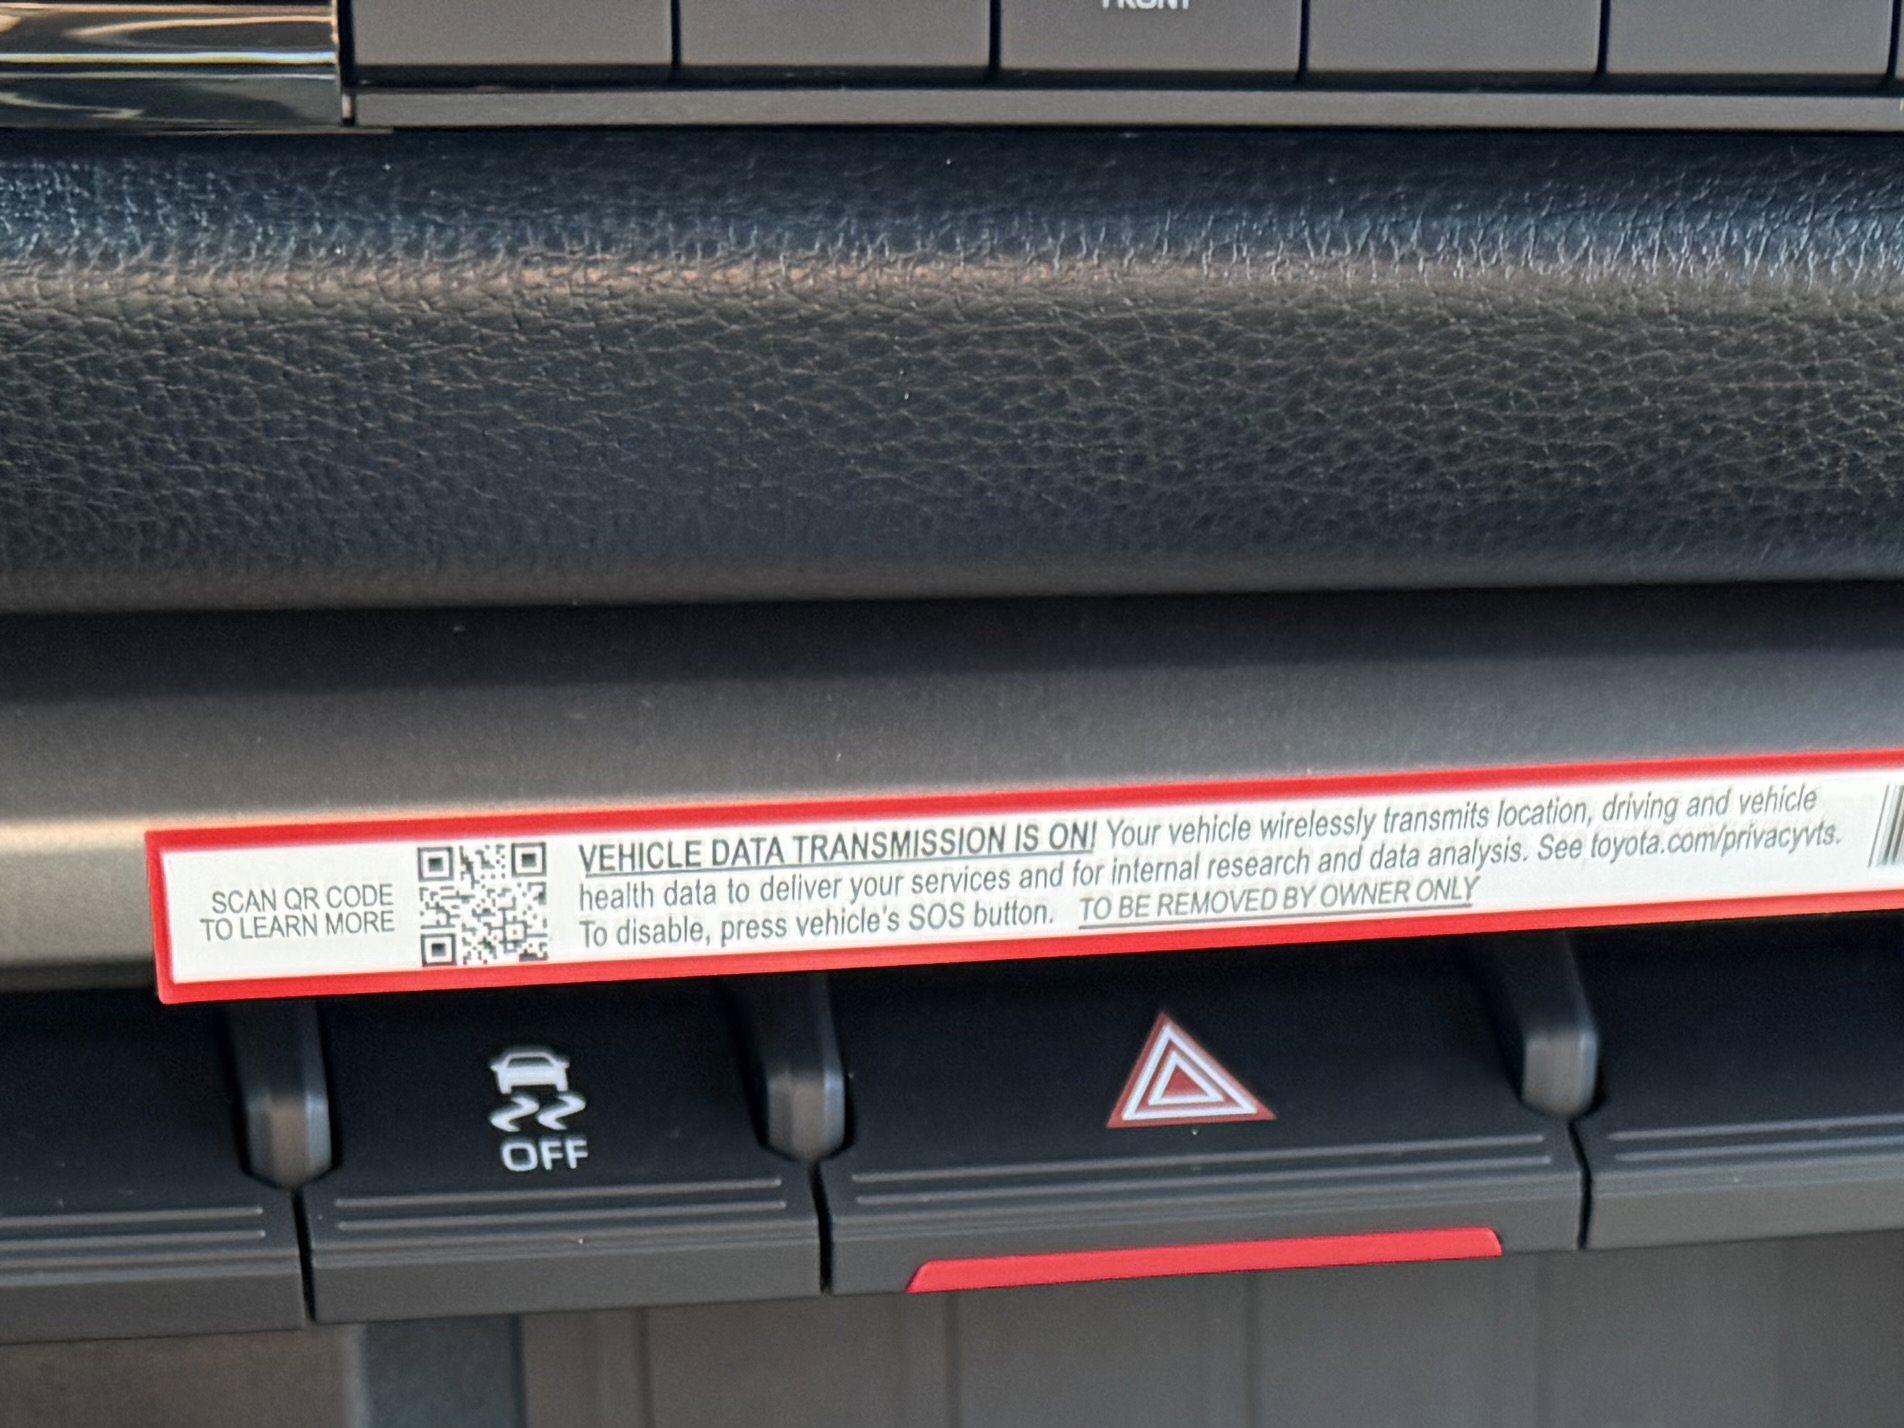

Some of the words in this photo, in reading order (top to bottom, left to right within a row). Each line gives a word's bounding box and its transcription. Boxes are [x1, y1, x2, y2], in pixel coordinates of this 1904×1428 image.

[578, 840, 702, 874] VEHICLE
[711, 836, 785, 867] DATA
[793, 826, 1006, 864] TRANSMISSION
[1015, 823, 1039, 853] IS
[1048, 821, 1098, 851] ON!
[1107, 818, 1161, 849] Your
[1168, 814, 1252, 844] vehicle
[1260, 808, 1377, 842] wirelessly
[1383, 802, 1490, 834] transmits
[1496, 797, 1592, 827] location,
[1602, 792, 1679, 825] driving
[1686, 789, 1732, 818] and
[1739, 785, 1818, 815] vehicle
[579, 880, 654, 912] health
[663, 878, 717, 907] data
[727, 877, 750, 904] to
[759, 873, 843, 902] deliver
[849, 874, 903, 905] your
[911, 866, 1011, 895] services
[1018, 860, 1065, 889] and
[1072, 859, 1105, 887] for
[1111, 853, 1201, 885] internal
[1207, 848, 1310, 879] research
[1317, 845, 1364, 873] and
[1369, 842, 1420, 870] data
[1427, 836, 1528, 872] analysis.
[1537, 834, 1583, 861] See
[1590, 821, 1839, 864] toyota.com/privacyvts.
[211, 888, 277, 914] SCAN
[283, 886, 321, 911] QR
[325, 883, 394, 909] CODE
[1080, 896, 1113, 921] TO
[1118, 894, 1151, 919] BE
[1156, 887, 1278, 917] REMOVED
[1282, 885, 1317, 910] BY
[1320, 879, 1411, 908] OWNER
[1416, 875, 1481, 902] ONLY
[200, 917, 234, 942] TO
[239, 913, 318, 940] LEARN
[325, 909, 395, 935] MORE
[579, 919, 608, 948] To
[616, 915, 711, 946] disable,
[720, 917, 788, 947] press
[795, 905, 900, 936] vehicle's
[908, 902, 965, 931] SOS
[973, 899, 1054, 928] button.
[501, 1136, 589, 1172] OFF
